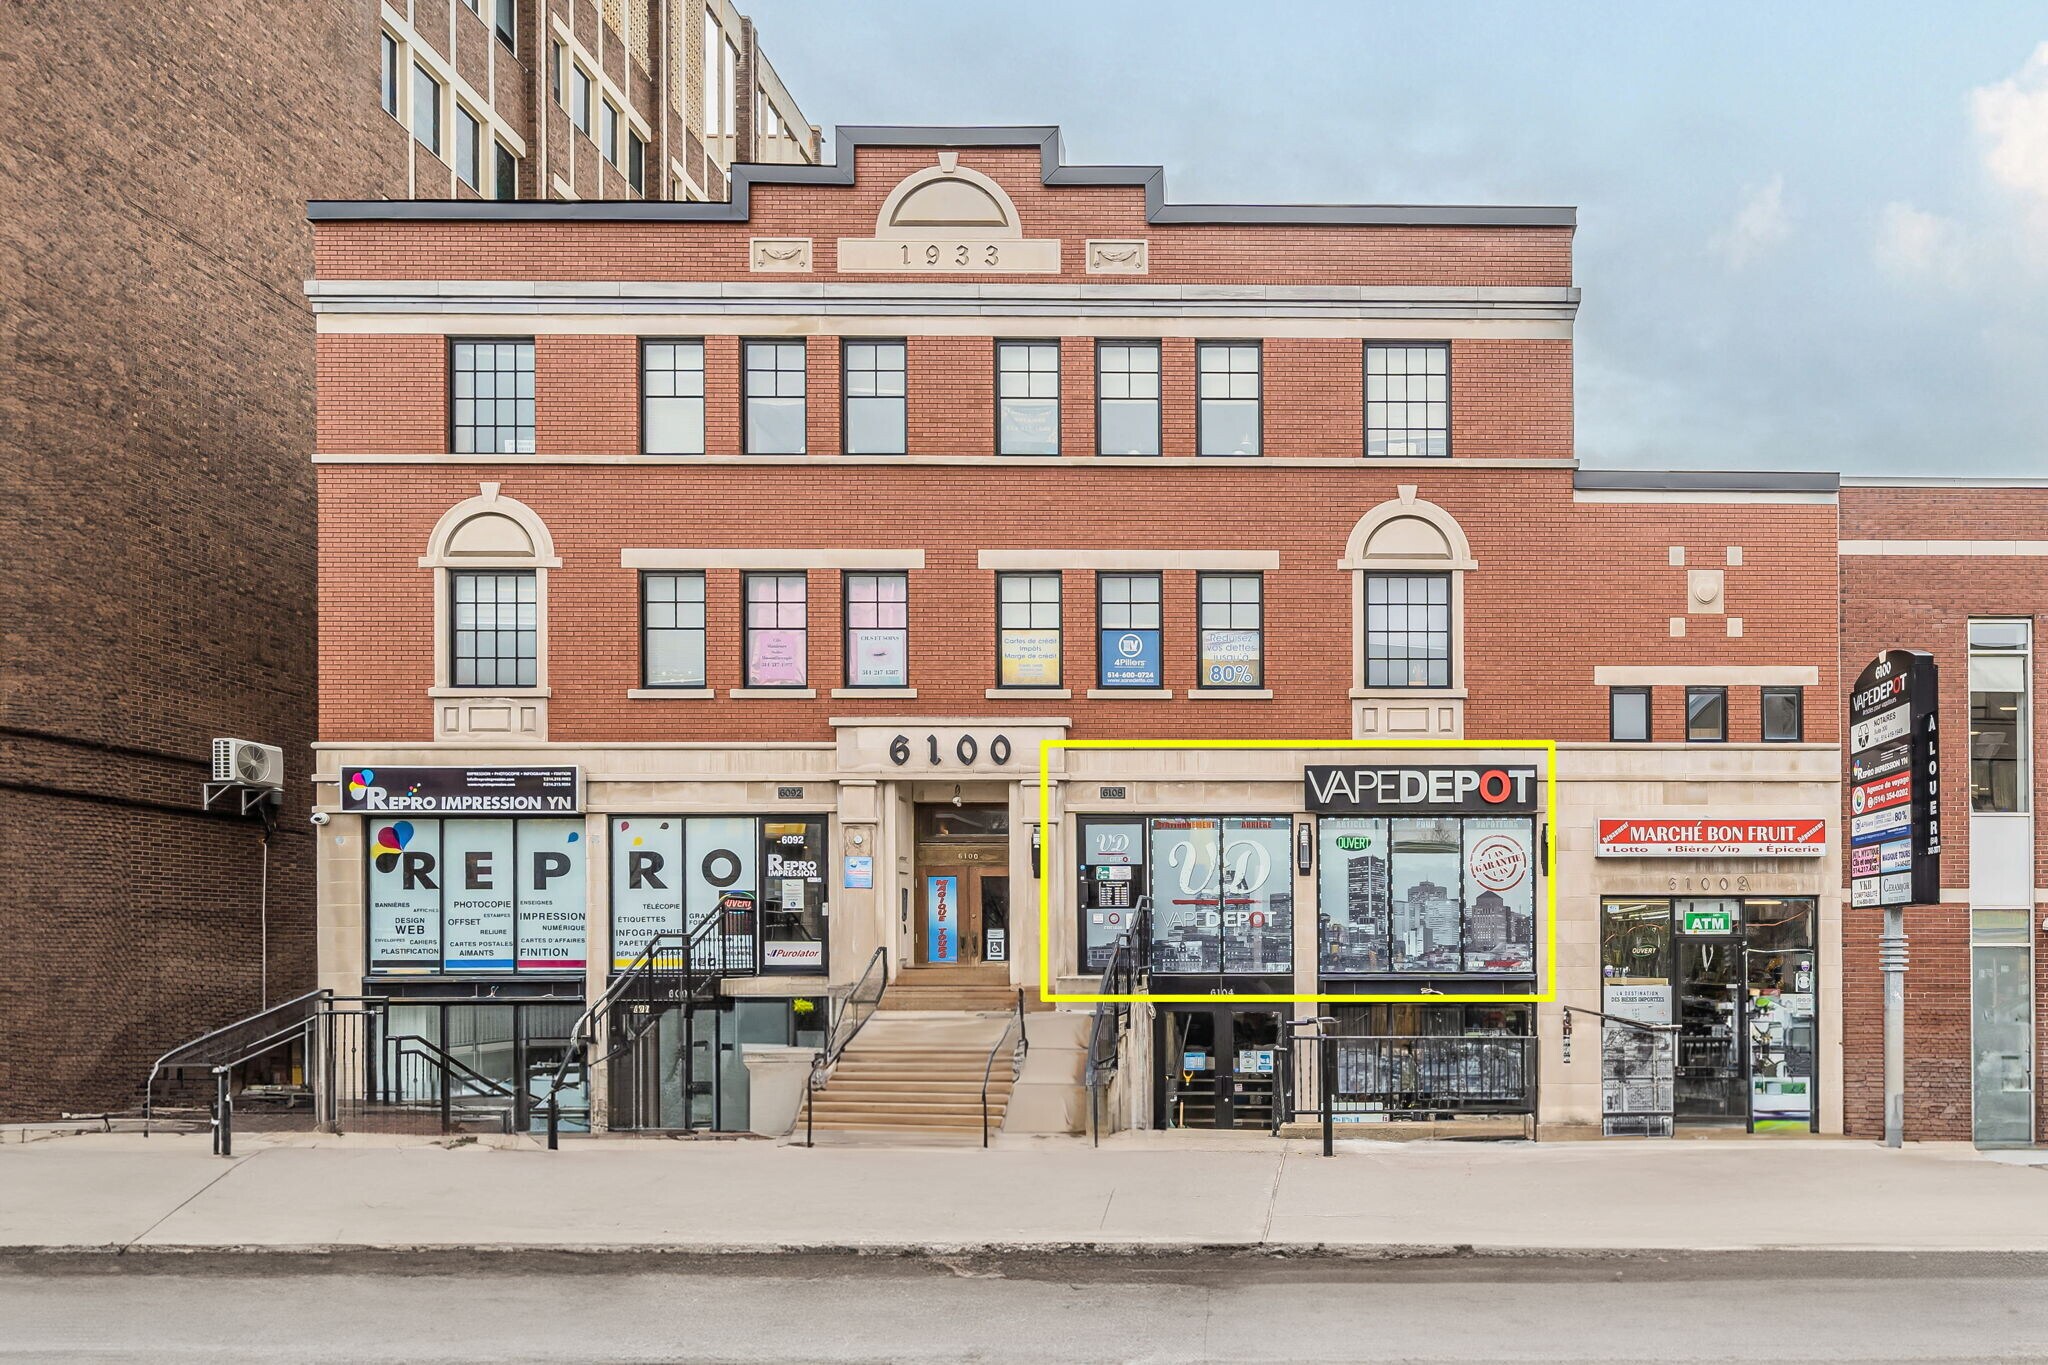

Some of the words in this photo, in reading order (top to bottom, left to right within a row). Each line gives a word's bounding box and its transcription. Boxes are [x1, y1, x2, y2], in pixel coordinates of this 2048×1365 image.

[900, 244, 999, 265] 1933
[1210, 665, 1252, 682] 80%
[1875, 661, 1891, 679] 6100
[1853, 673, 1907, 711] VAPEDEPOT
[889, 734, 1011, 766] 6100
[1307, 769, 1535, 804] VAPEDEPOT
[1884, 781, 1891, 789] de
[367, 787, 437, 810] REPRO
[441, 796, 542, 810] IMPRESSION
[547, 796, 571, 810] YN
[780, 788, 803, 798] 6092
[1102, 788, 1124, 798] 6108
[1630, 821, 1703, 841] MARCHÉ
[1707, 826, 1743, 841] BON
[1748, 826, 1796, 841] FRUIT
[781, 836, 804, 844] 6092
[1337, 838, 1371, 849] OUVERT
[1766, 844, 1820, 854] Épicerie
[768, 854, 817, 871] REPRO
[1474, 854, 1522, 872] GARANTIE
[768, 869, 817, 877] IMPRESSION
[1161, 911, 1277, 928] VAPEDEPOT
[1692, 917, 1724, 930] ATM
[395, 925, 425, 935] WEB
[520, 948, 569, 956] FINITION
[776, 949, 819, 958] Purolator
